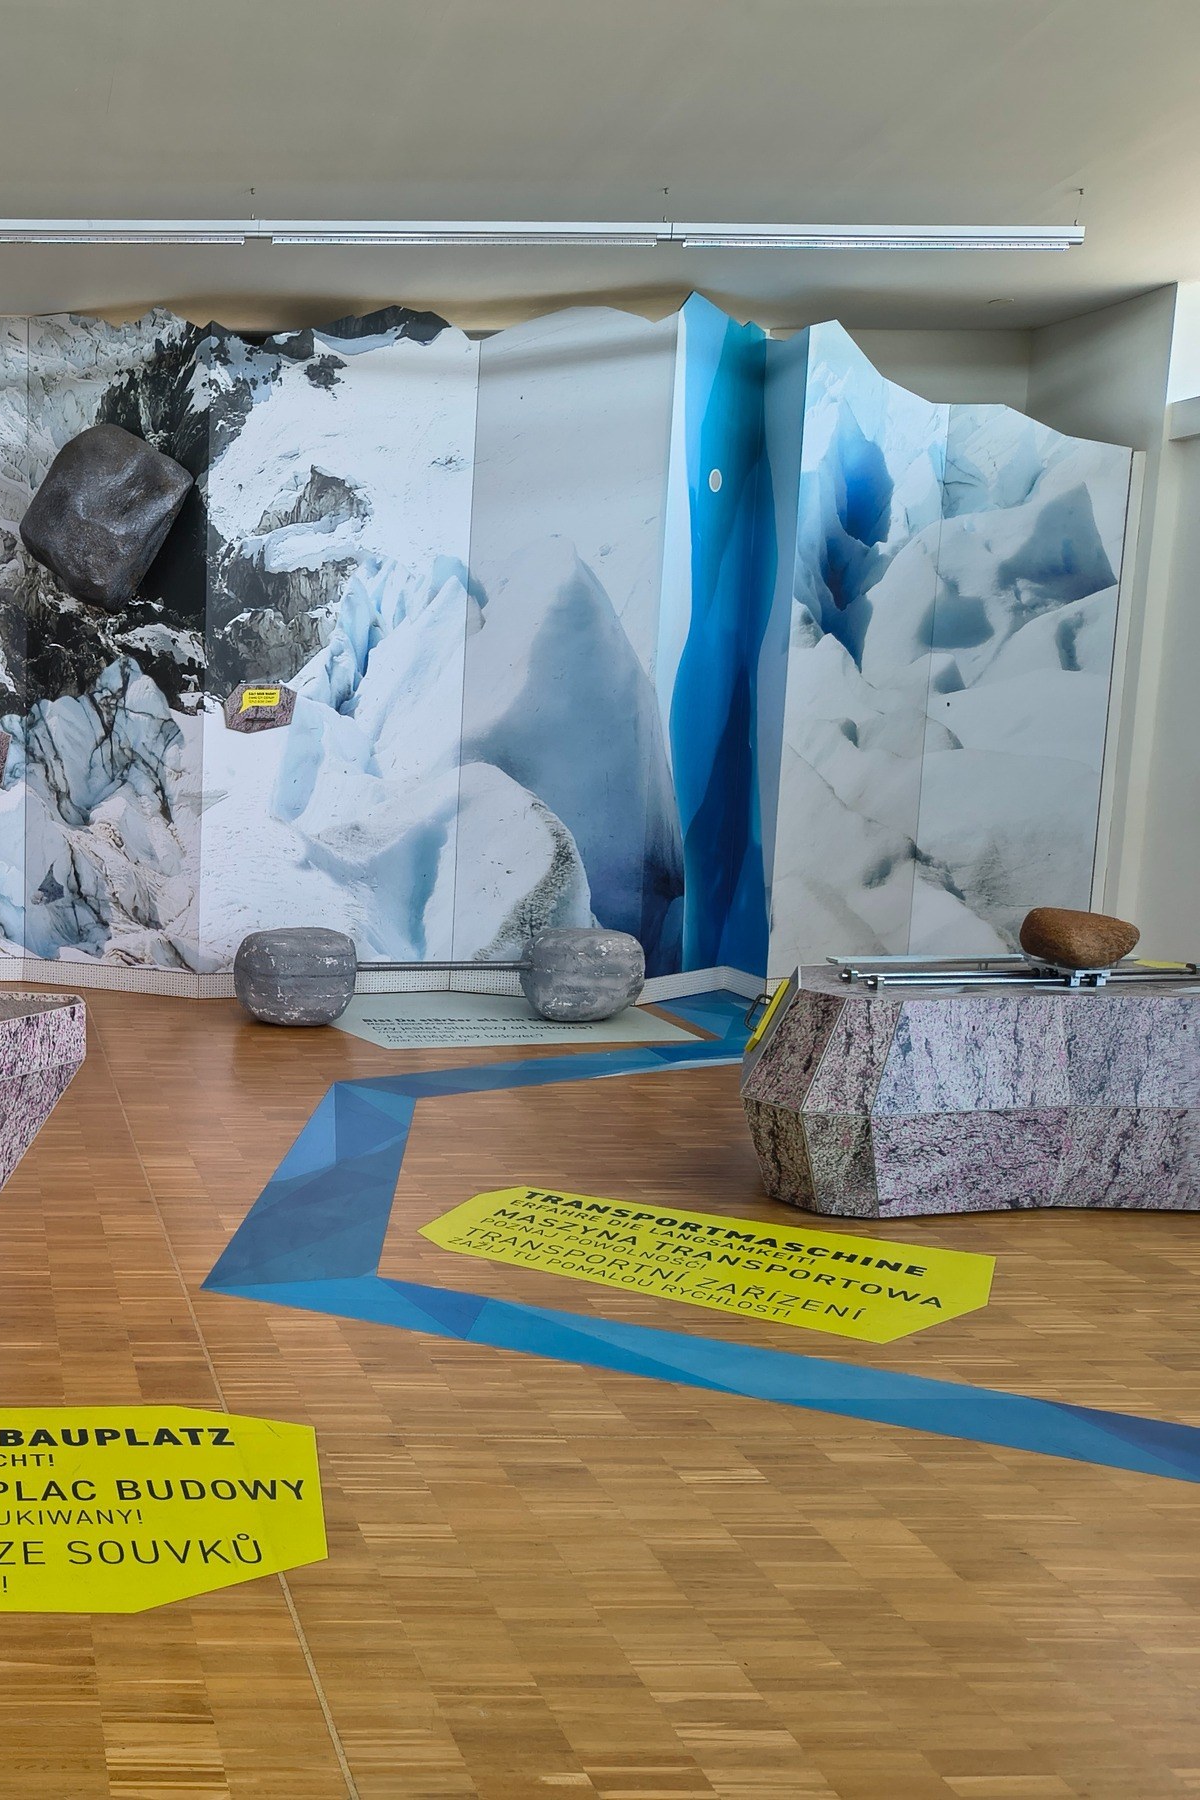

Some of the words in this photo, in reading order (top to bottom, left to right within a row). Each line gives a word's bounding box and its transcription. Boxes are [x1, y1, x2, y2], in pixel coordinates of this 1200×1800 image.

[480, 1217, 559, 1238] POZNAJ
[564, 1235, 708, 1271] POWOLNOŚĆ!
[493, 1208, 638, 1246] MASZYNA
[655, 1240, 943, 1309] TRANSPORTOWA
[510, 1199, 603, 1222] ERFAHRE
[607, 1219, 644, 1231] DIE
[649, 1227, 817, 1266] LANGSAMKEIT!
[525, 1190, 929, 1277] TRANSPORTMASCHINE
[447, 1236, 507, 1255] ZAŽIJ
[514, 1250, 544, 1262] TU
[546, 1258, 655, 1288] POMALOU
[661, 1284, 792, 1319] RYCHLOST!
[465, 1226, 692, 1283] TRANSPORTNÍ
[696, 1276, 868, 1320] ZAŘÍZENÍ
[116, 1479, 305, 1501] BUDOWY
[67, 1533, 264, 1566] SOUVKŮ
